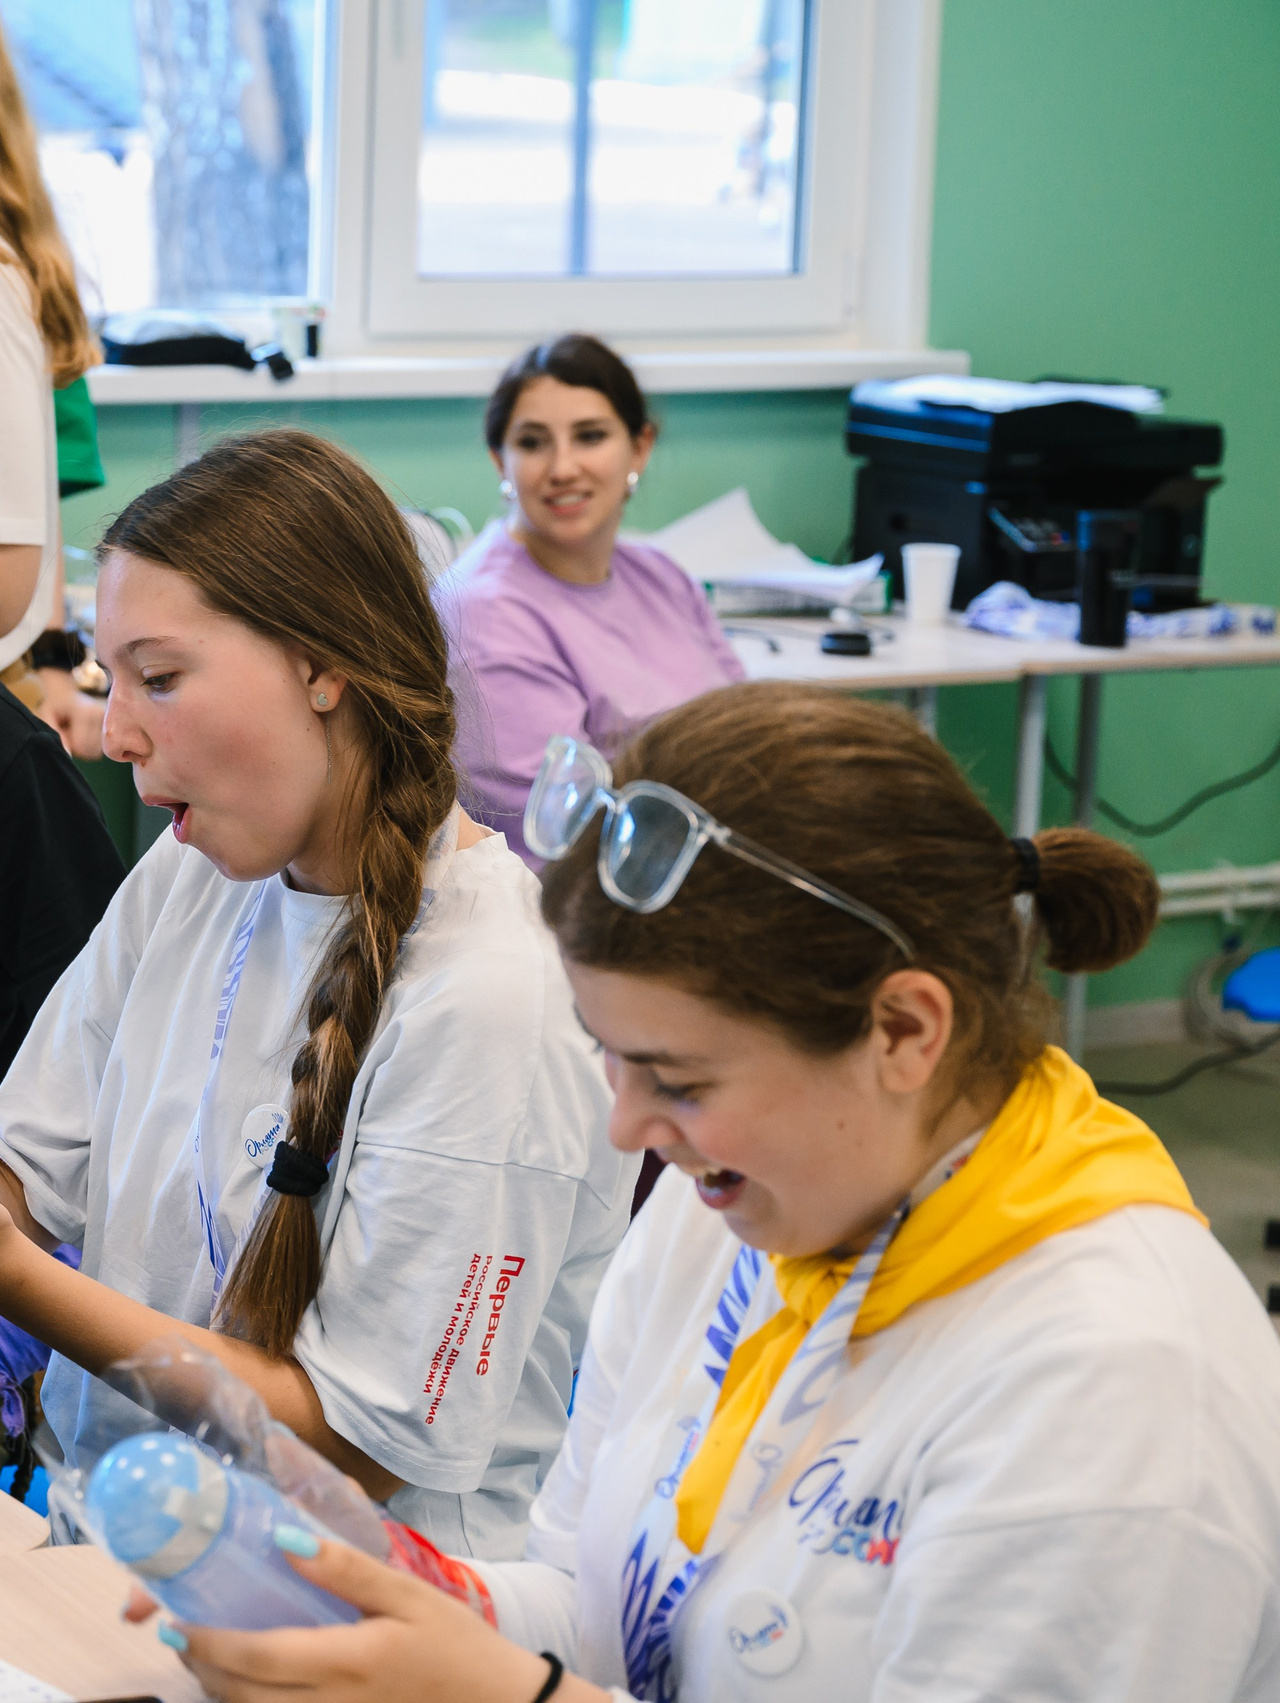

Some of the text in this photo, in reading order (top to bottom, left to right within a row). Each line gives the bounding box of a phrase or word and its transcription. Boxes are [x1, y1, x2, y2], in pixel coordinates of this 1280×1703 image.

[245, 1124, 280, 1157] Орлята
[423, 1253, 482, 1394] детей и молодёжи
[476, 1254, 526, 1376] Первые
[425, 1348, 460, 1425] движение
